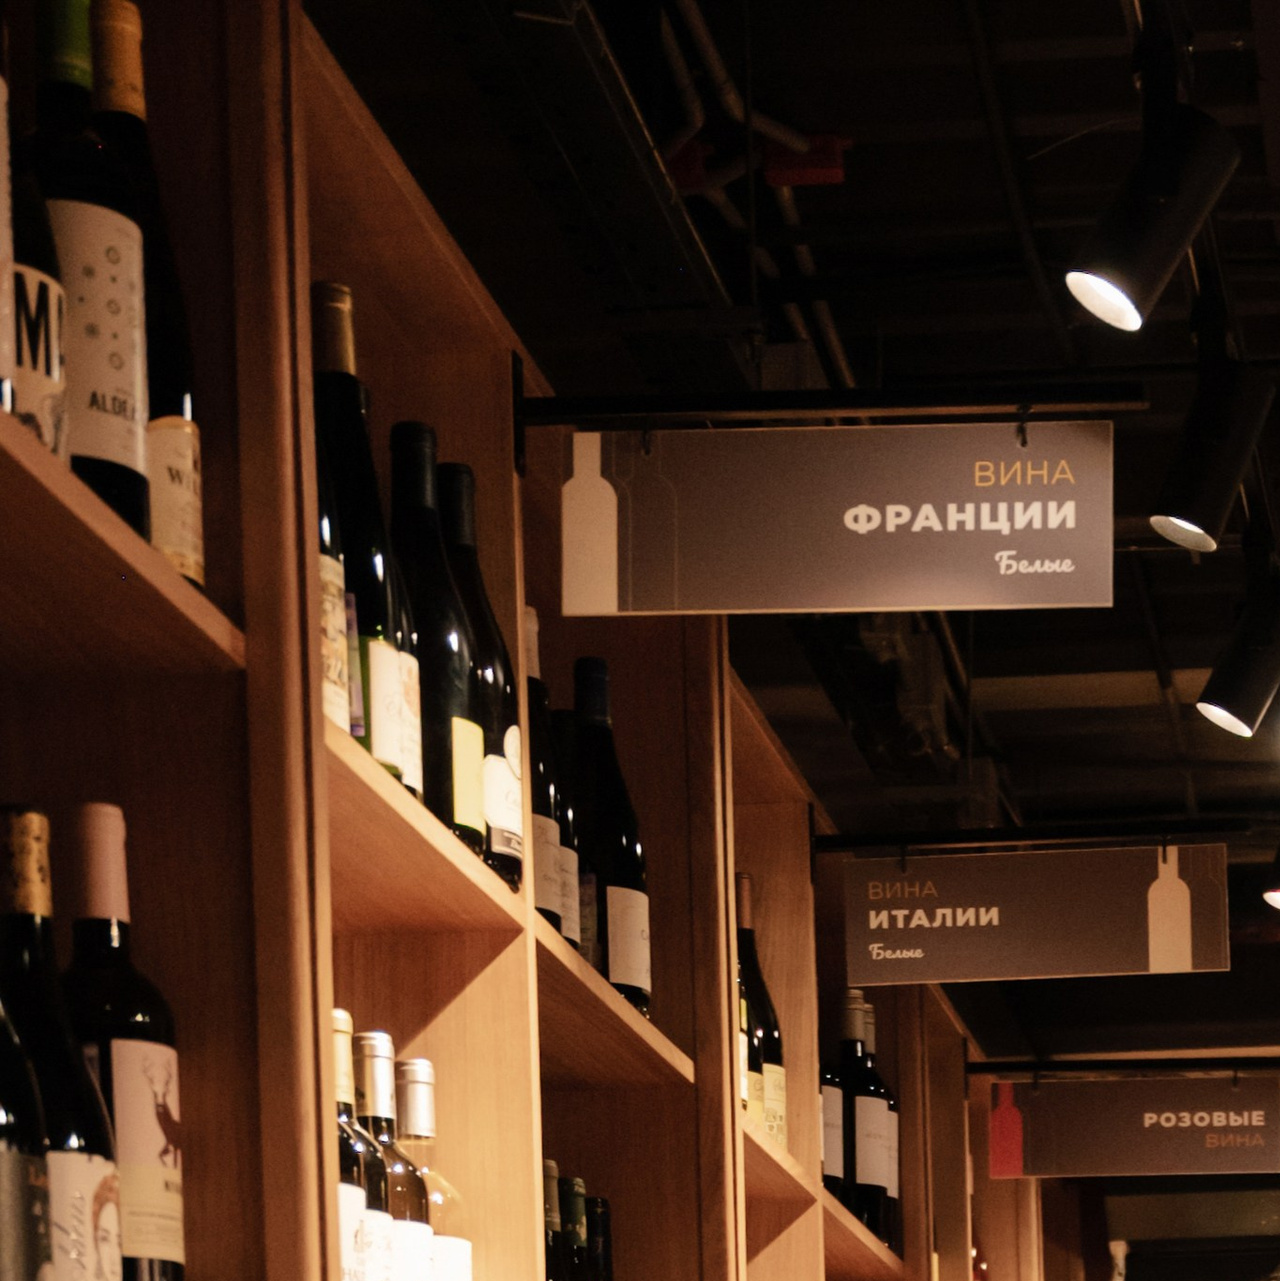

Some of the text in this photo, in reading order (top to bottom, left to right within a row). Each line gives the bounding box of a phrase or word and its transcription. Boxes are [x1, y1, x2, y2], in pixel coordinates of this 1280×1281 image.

[974, 460, 1076, 487] ВИНА
[843, 500, 1077, 535] ФРАНЦИИ
[994, 549, 1077, 576] Белые
[868, 880, 939, 900] ВИНА
[868, 906, 1001, 931] ИТАЛИИ
[868, 943, 926, 961] Белые
[1142, 1110, 1266, 1129] РОЗОВЫЕ
[1204, 1133, 1266, 1149] ВИНА
